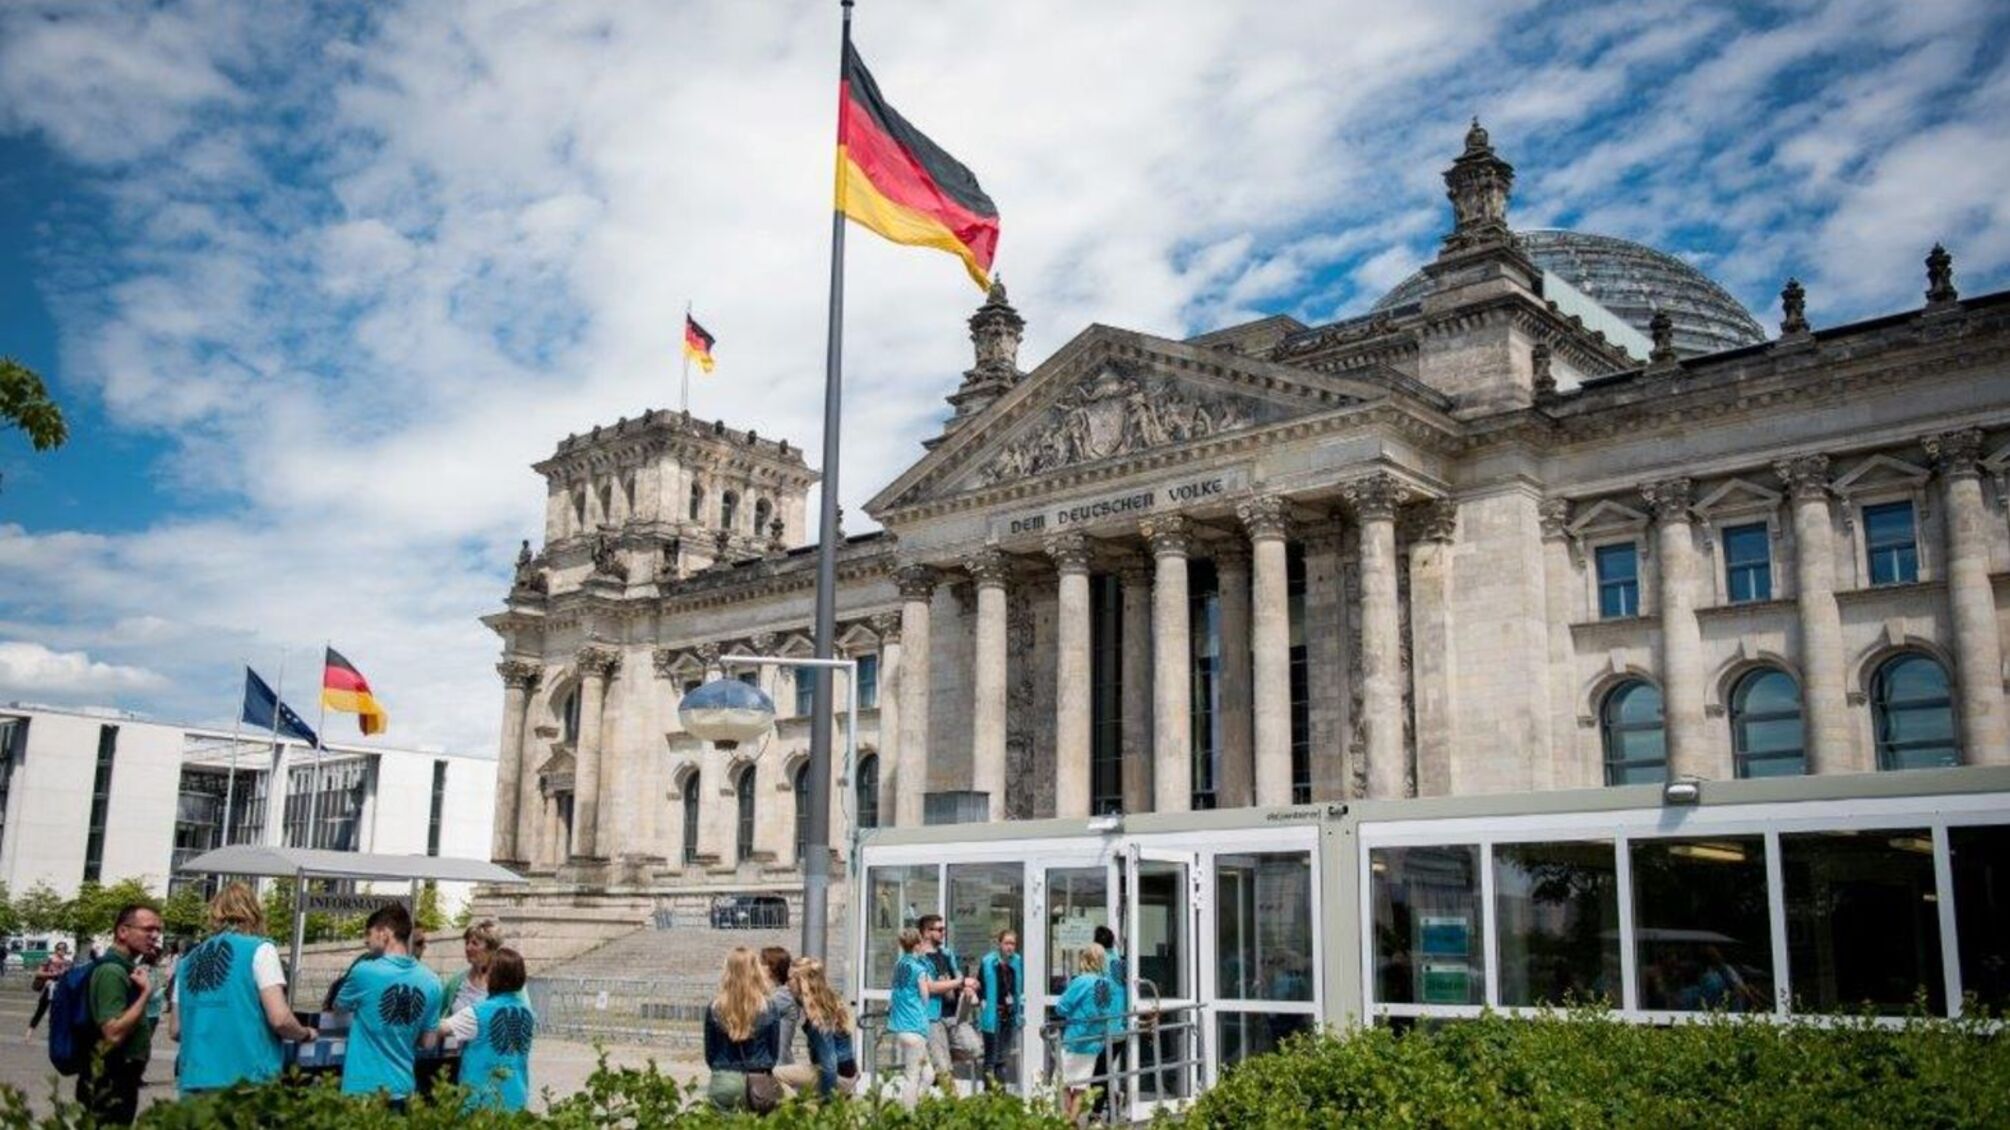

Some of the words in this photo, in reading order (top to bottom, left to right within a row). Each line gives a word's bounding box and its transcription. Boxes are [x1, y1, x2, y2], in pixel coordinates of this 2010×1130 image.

[1010, 514, 1046, 534] DEM
[1058, 492, 1155, 525] DEUTSCHEN
[1168, 478, 1223, 502] VOLKE
